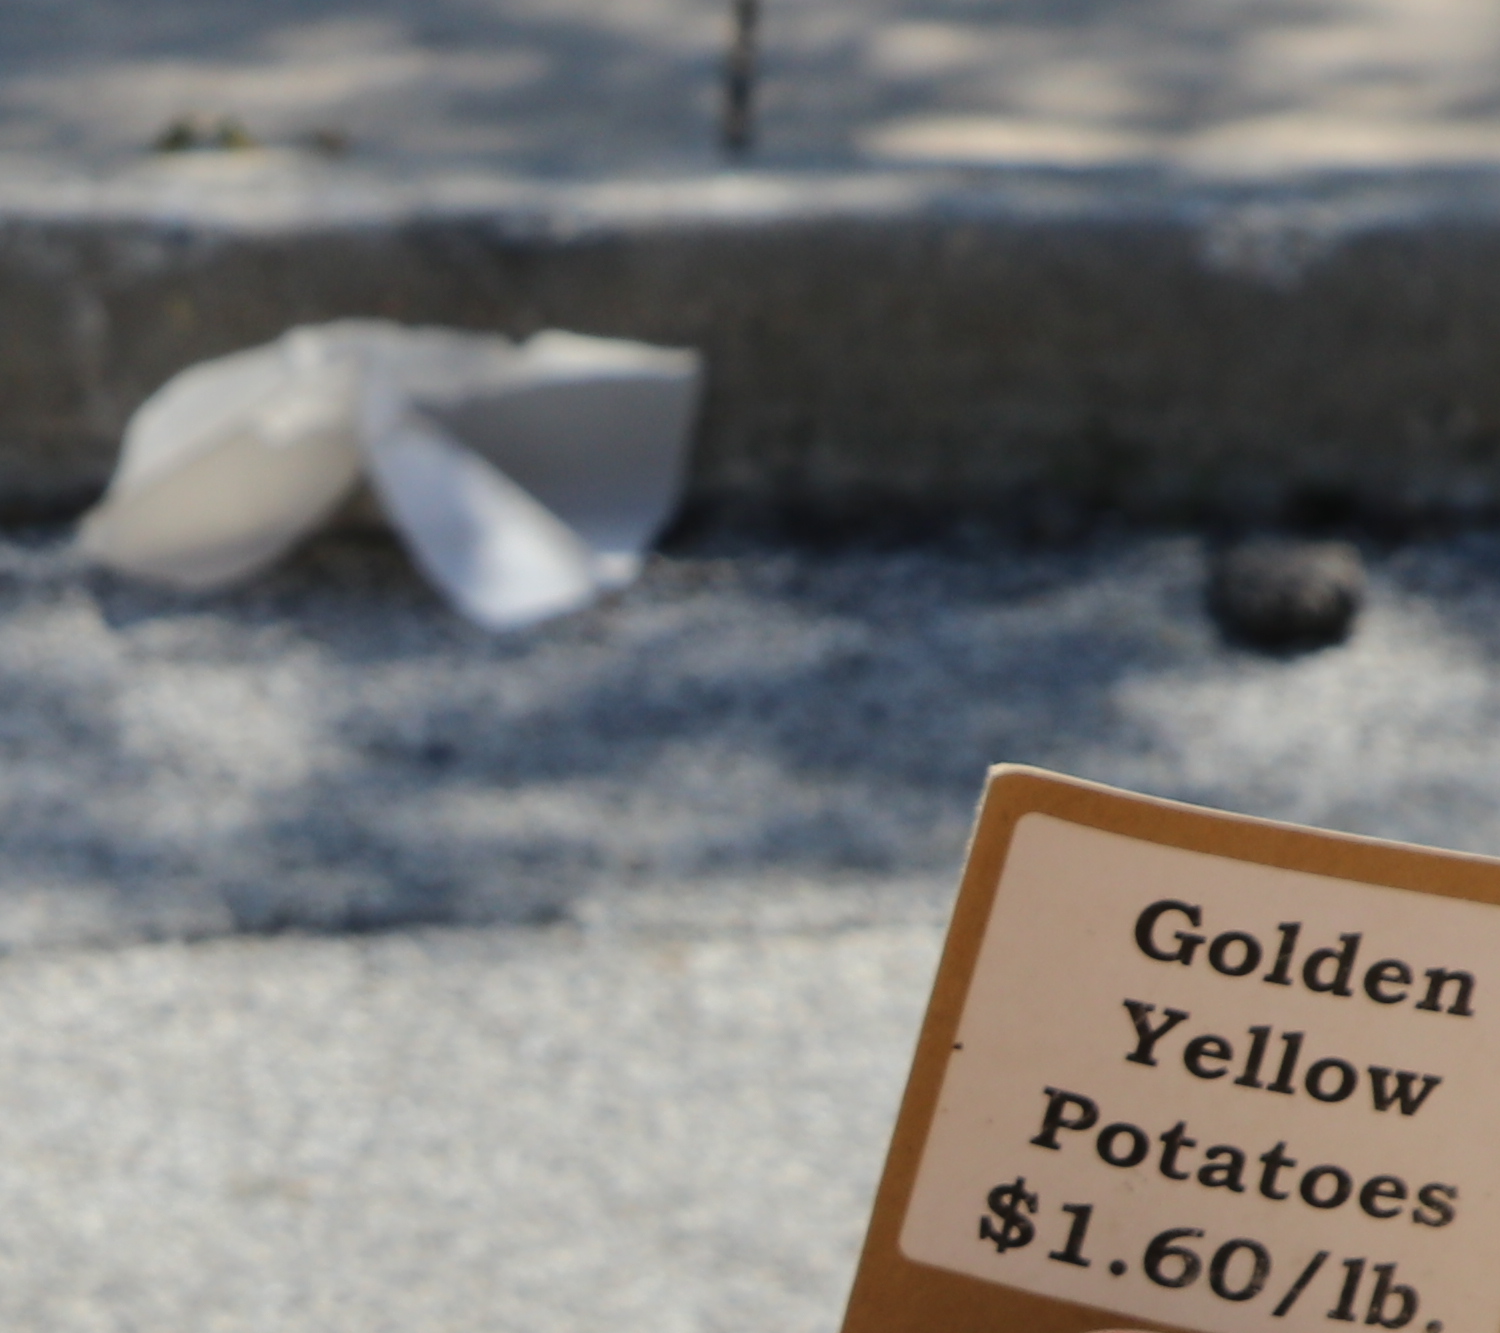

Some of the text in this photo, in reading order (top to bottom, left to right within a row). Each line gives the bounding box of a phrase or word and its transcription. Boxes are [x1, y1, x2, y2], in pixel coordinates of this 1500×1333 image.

[1132, 898, 1475, 1018] Golden
[1122, 998, 1442, 1116] Yellow
[1030, 1086, 1459, 1228] Potatoes
